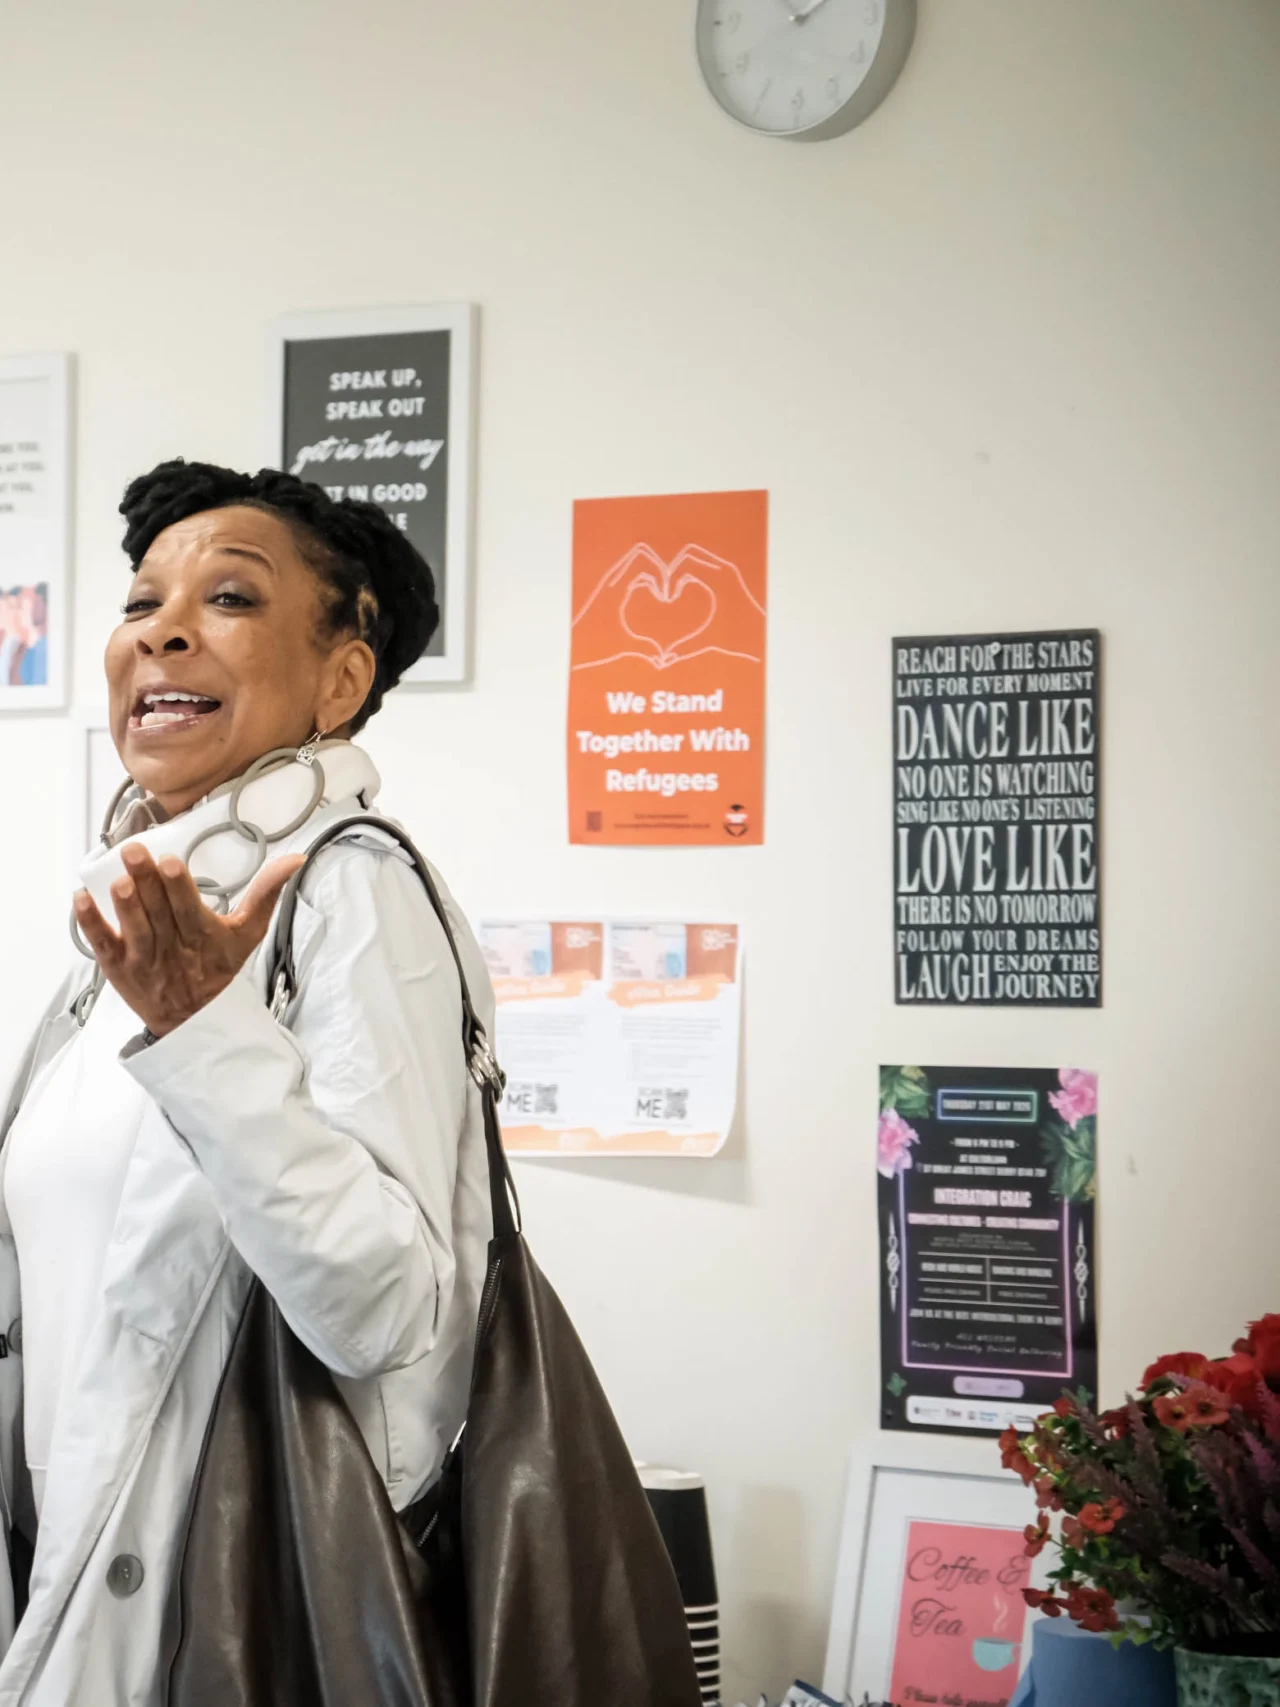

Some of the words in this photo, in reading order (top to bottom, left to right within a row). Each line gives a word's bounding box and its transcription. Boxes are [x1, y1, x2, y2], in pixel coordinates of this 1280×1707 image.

[329, 370, 387, 391] SPEAK
[391, 368, 422, 387] UP,
[326, 400, 383, 421] SPEAK
[388, 397, 425, 417] OUT
[289, 435, 340, 475] get
[334, 437, 363, 461] in
[363, 430, 401, 460] the
[348, 485, 369, 501] IN
[372, 482, 428, 502] GOOD
[897, 646, 955, 674] REACH
[960, 645, 997, 672] FOR
[1001, 643, 1033, 670] THE
[1038, 639, 1093, 668] STARS
[897, 677, 933, 698] LIVE
[937, 676, 968, 696] FOR
[972, 674, 1023, 695] EVERY
[1026, 672, 1093, 692] MOMENT
[606, 691, 646, 714] We
[651, 689, 723, 713] Stand
[576, 729, 684, 758] Together
[689, 727, 750, 752] With
[897, 701, 1010, 761] DANCE
[1018, 698, 1095, 756] LIKE
[606, 768, 718, 797] Refugees
[897, 765, 925, 799] NO
[929, 764, 969, 797] ONE
[973, 764, 992, 796] IS
[996, 761, 1094, 796] WATCHING
[897, 801, 928, 823] SING
[930, 800, 959, 822] LIKE
[962, 800, 980, 822] NO
[1024, 797, 1094, 820] LISTENING
[898, 825, 996, 894] LOVE
[1006, 824, 1096, 892] LIKE
[898, 896, 951, 925] THERE
[955, 896, 970, 924] IS
[974, 895, 997, 924] NO
[1000, 894, 1096, 924] TOMORROW
[897, 929, 964, 952] FOLLOW
[972, 929, 1016, 951] YOUR
[1026, 929, 1099, 951] DREAMS
[994, 954, 1054, 972] ENJOY
[1059, 954, 1099, 972] THE
[899, 953, 990, 1001] LAUGH
[994, 974, 1100, 999] JOURNEY
[506, 1093, 532, 1113] ME
[636, 1099, 663, 1118] ME
[934, 1188, 998, 1206] INTEGRATION
[1000, 1190, 1032, 1208] CRAIC
[907, 1547, 991, 1592] Coffee
[996, 1554, 1029, 1595] &
[910, 1597, 965, 1638] Tea
